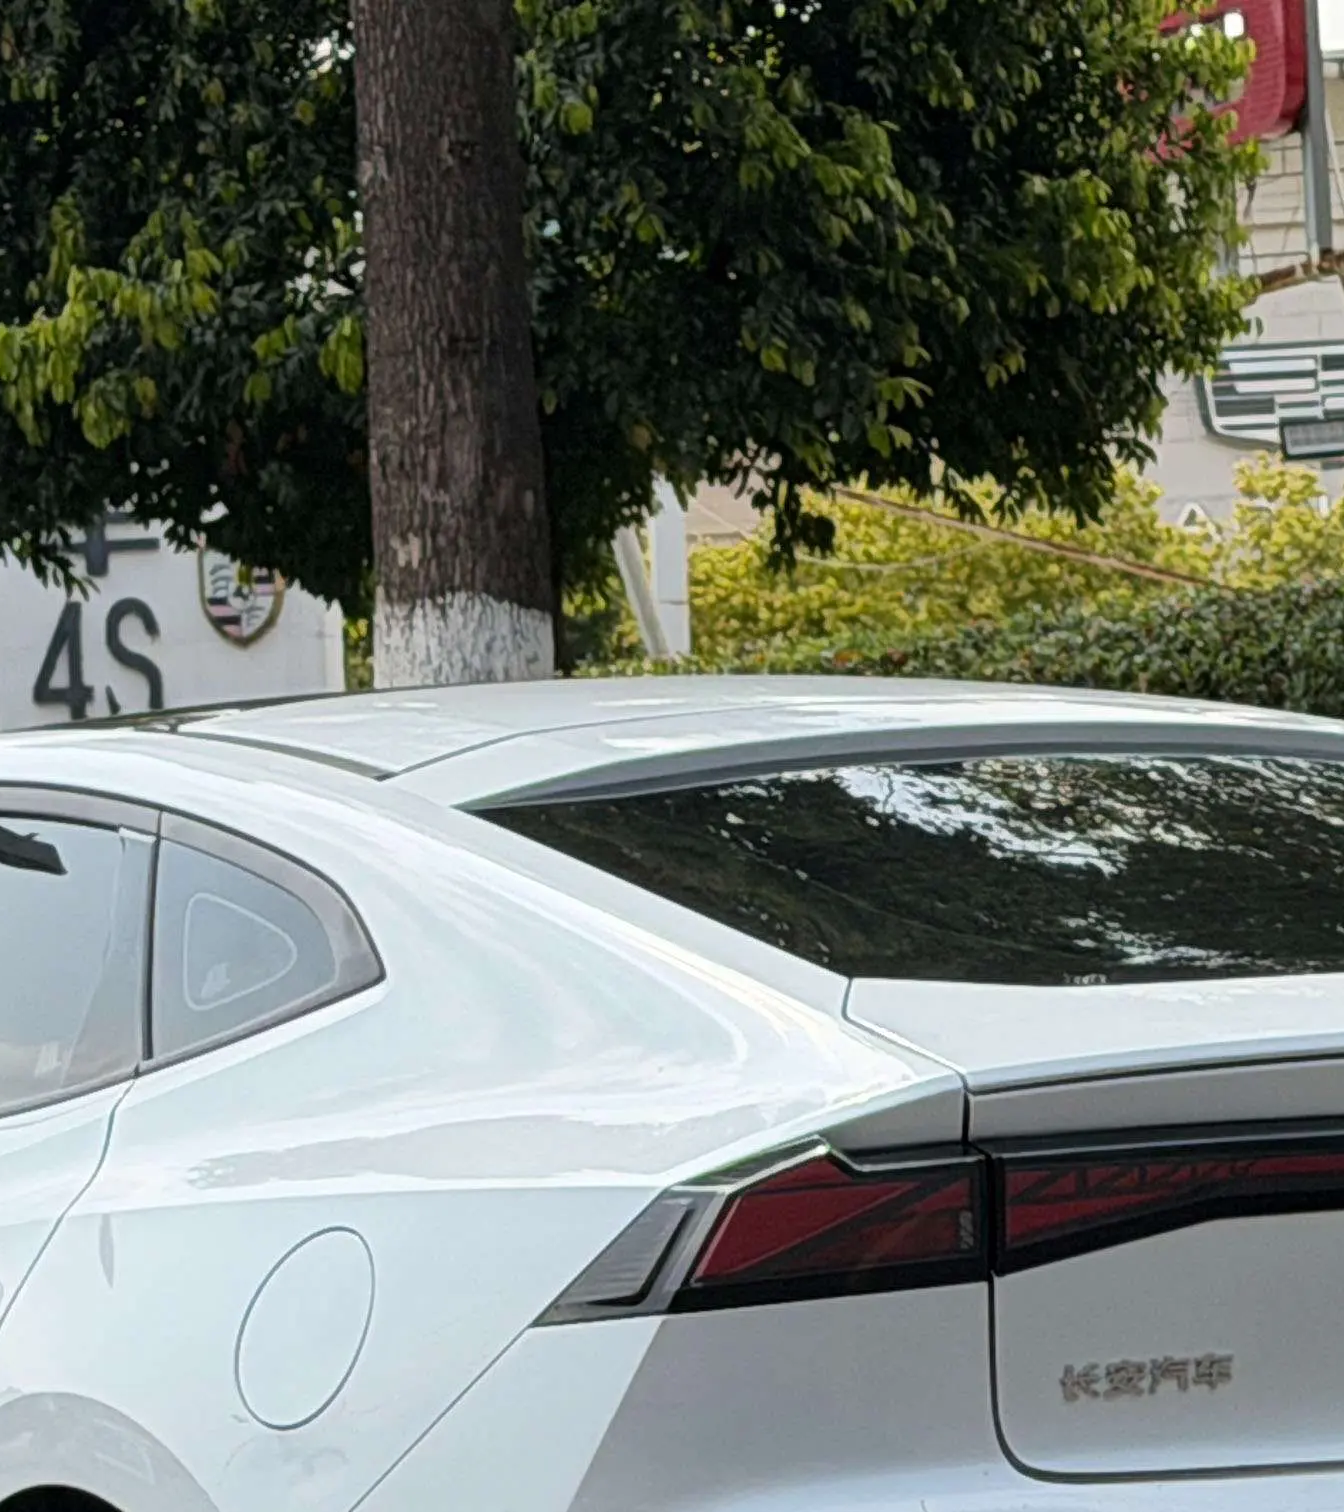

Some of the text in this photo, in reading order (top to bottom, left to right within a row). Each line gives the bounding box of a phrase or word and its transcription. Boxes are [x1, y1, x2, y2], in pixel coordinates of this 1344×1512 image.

[33, 597, 164, 720] 4S
[1059, 1353, 1234, 1402] 长安汽车
